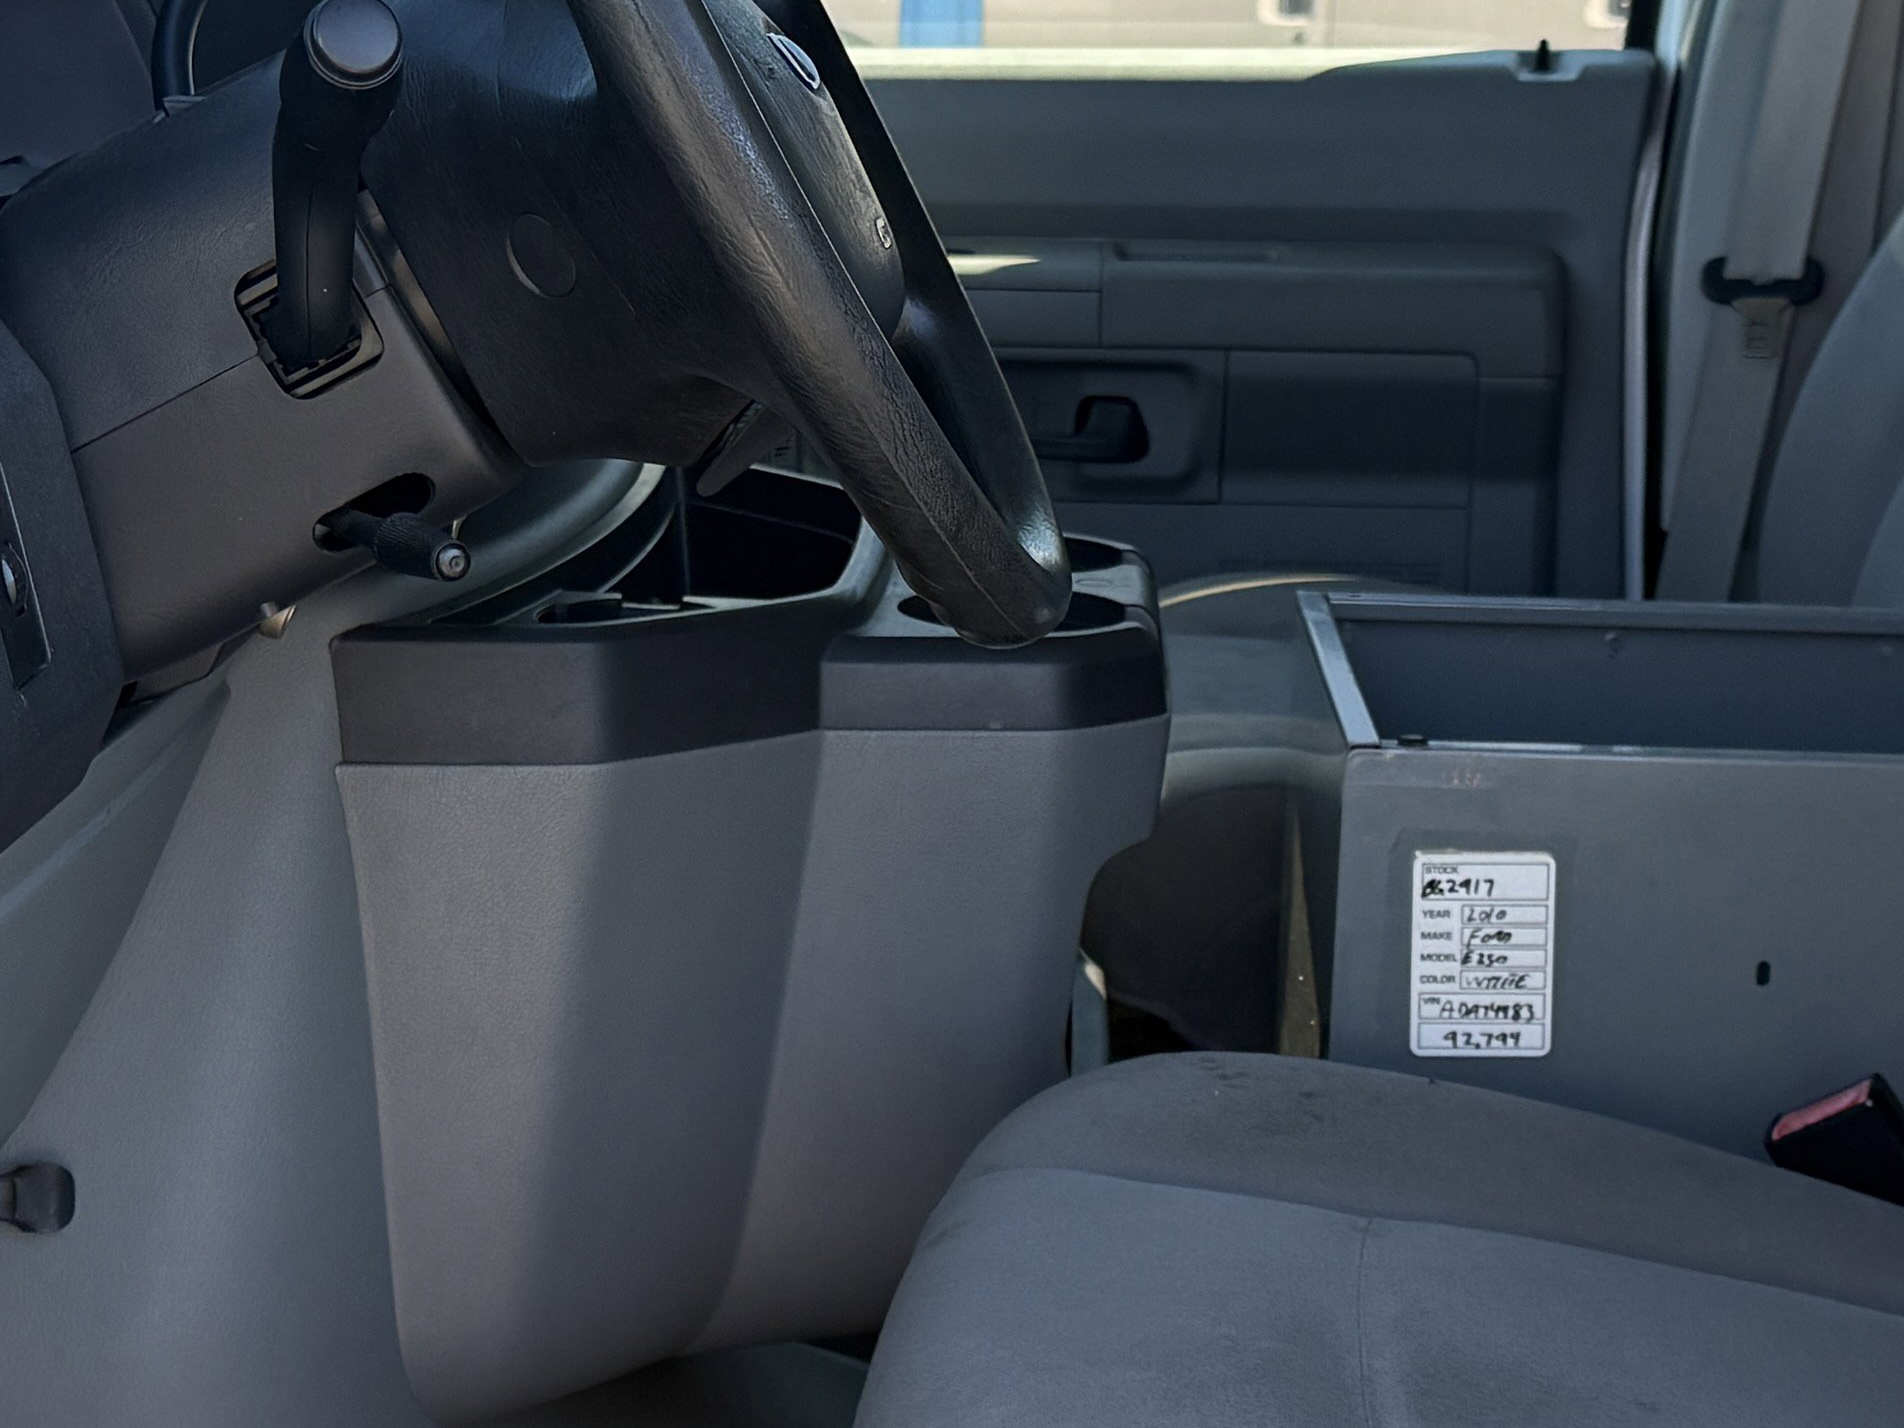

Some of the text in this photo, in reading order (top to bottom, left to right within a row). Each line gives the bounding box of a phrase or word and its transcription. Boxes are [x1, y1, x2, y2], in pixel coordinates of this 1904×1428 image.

[1422, 910, 1451, 919] YEAR
[1420, 932, 1453, 941] MAKE
[1420, 953, 1458, 963] MODEL
[1419, 975, 1456, 985] COLOR
